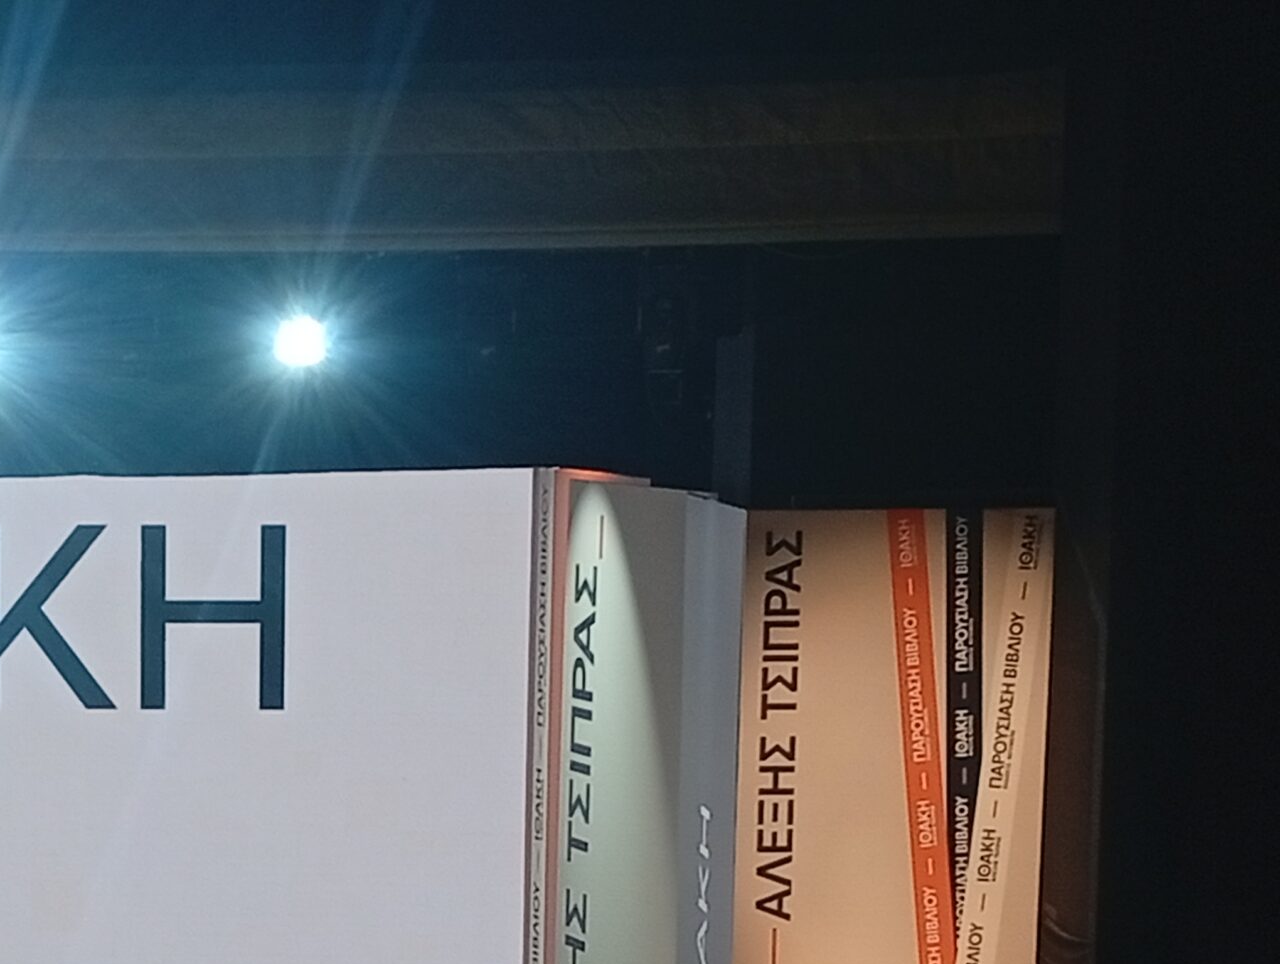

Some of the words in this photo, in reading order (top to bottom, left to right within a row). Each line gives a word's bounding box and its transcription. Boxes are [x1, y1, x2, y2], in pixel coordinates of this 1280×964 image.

[898, 518, 912, 568] ΙΘΑΚΗ
[955, 515, 969, 575] ΒΙΒΛΙΟΥ
[760, 530, 804, 720] ΤΣΙΠΡΑΣ
[903, 608, 919, 667] ΒΙΒΛΙΟΥ
[954, 576, 970, 672] ΠΑΡΟΥΣΙΑΣΗ
[567, 564, 598, 862] ΤΣΙΠΡΑΣ
[906, 668, 924, 763] ΠΑΡΟΥΣΙΑΣΗ
[977, 828, 997, 883] ΙΘΑΚΗ
[989, 681, 1016, 789] ΠΑΡΟΥΣΙΑΣΗ
[1003, 611, 1025, 679] ΒΙΒΛΙΟΥ
[1017, 514, 1039, 571] ΙΘΑΚΗ
[954, 708, 970, 758] ΙΘΑΚΗ
[533, 767, 544, 841] ΙΘΑΚΗ
[755, 735, 797, 921] ΑΛΕΞΗΣ
[917, 800, 931, 848] ΙΘΑΚΗ
[954, 795, 969, 855] ΒΙΒΛΙΟΥ
[922, 886, 937, 944] ΒΙΒΛΙΟΥ
